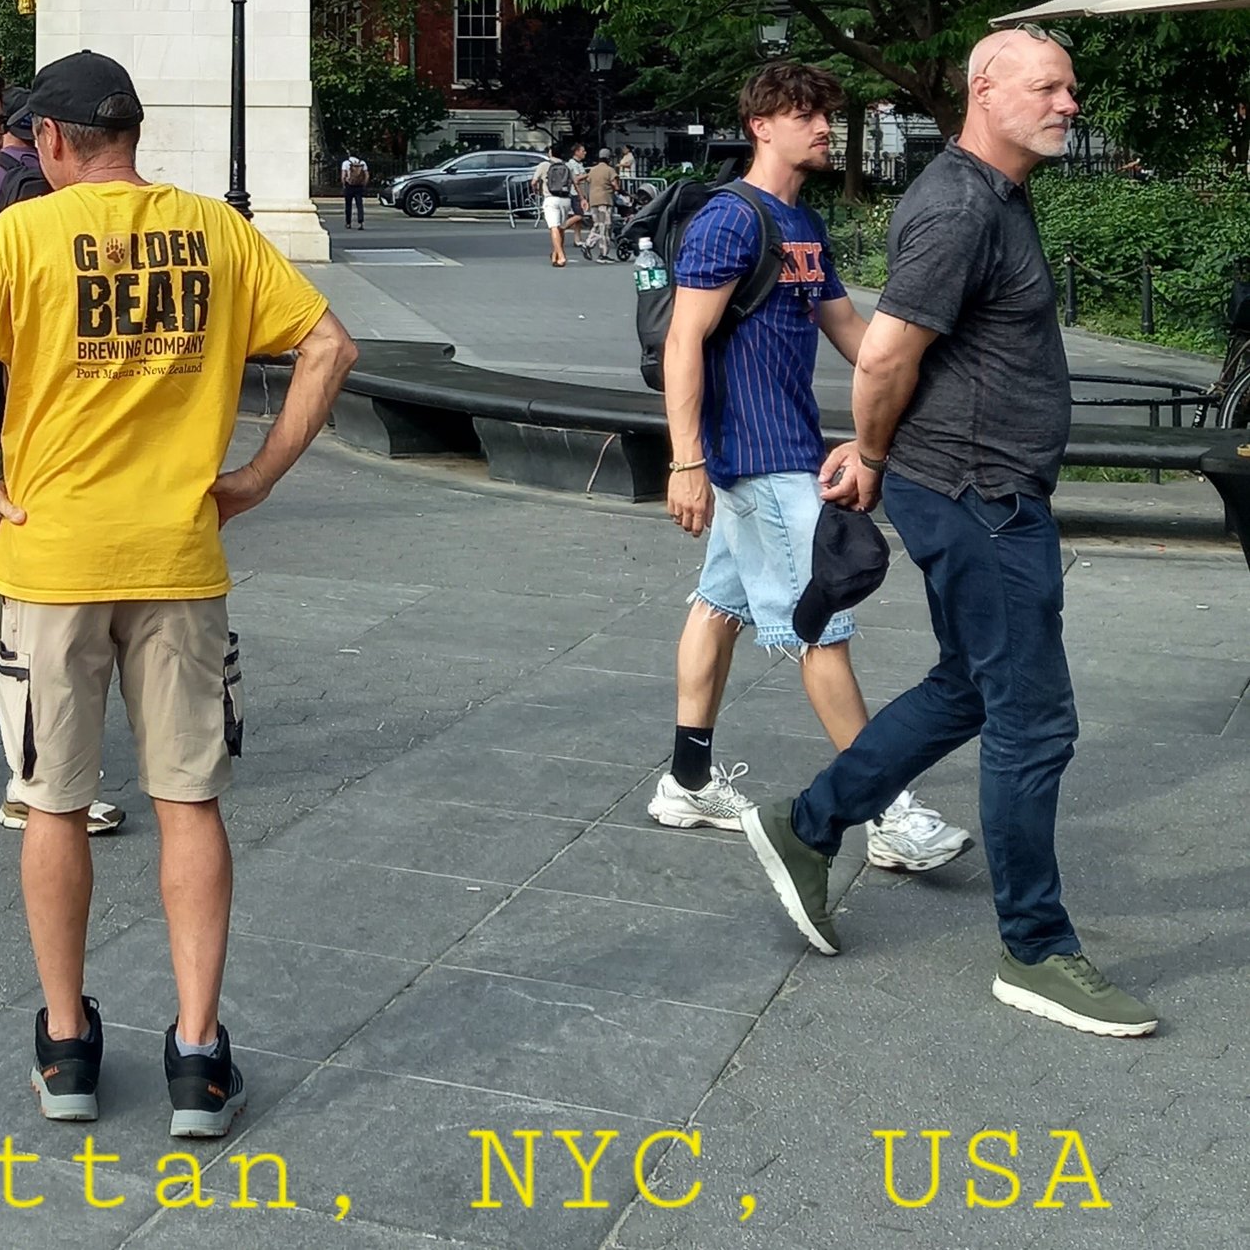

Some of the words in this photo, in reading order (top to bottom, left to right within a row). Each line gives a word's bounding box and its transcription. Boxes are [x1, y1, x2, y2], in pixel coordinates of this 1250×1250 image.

[76, 269, 211, 338] BEAR
[77, 339, 142, 361] BREWING
[143, 335, 206, 356] COMPANY
[76, 367, 101, 380] Port
[142, 366, 167, 378] New
[167, 362, 203, 376] Zealand
